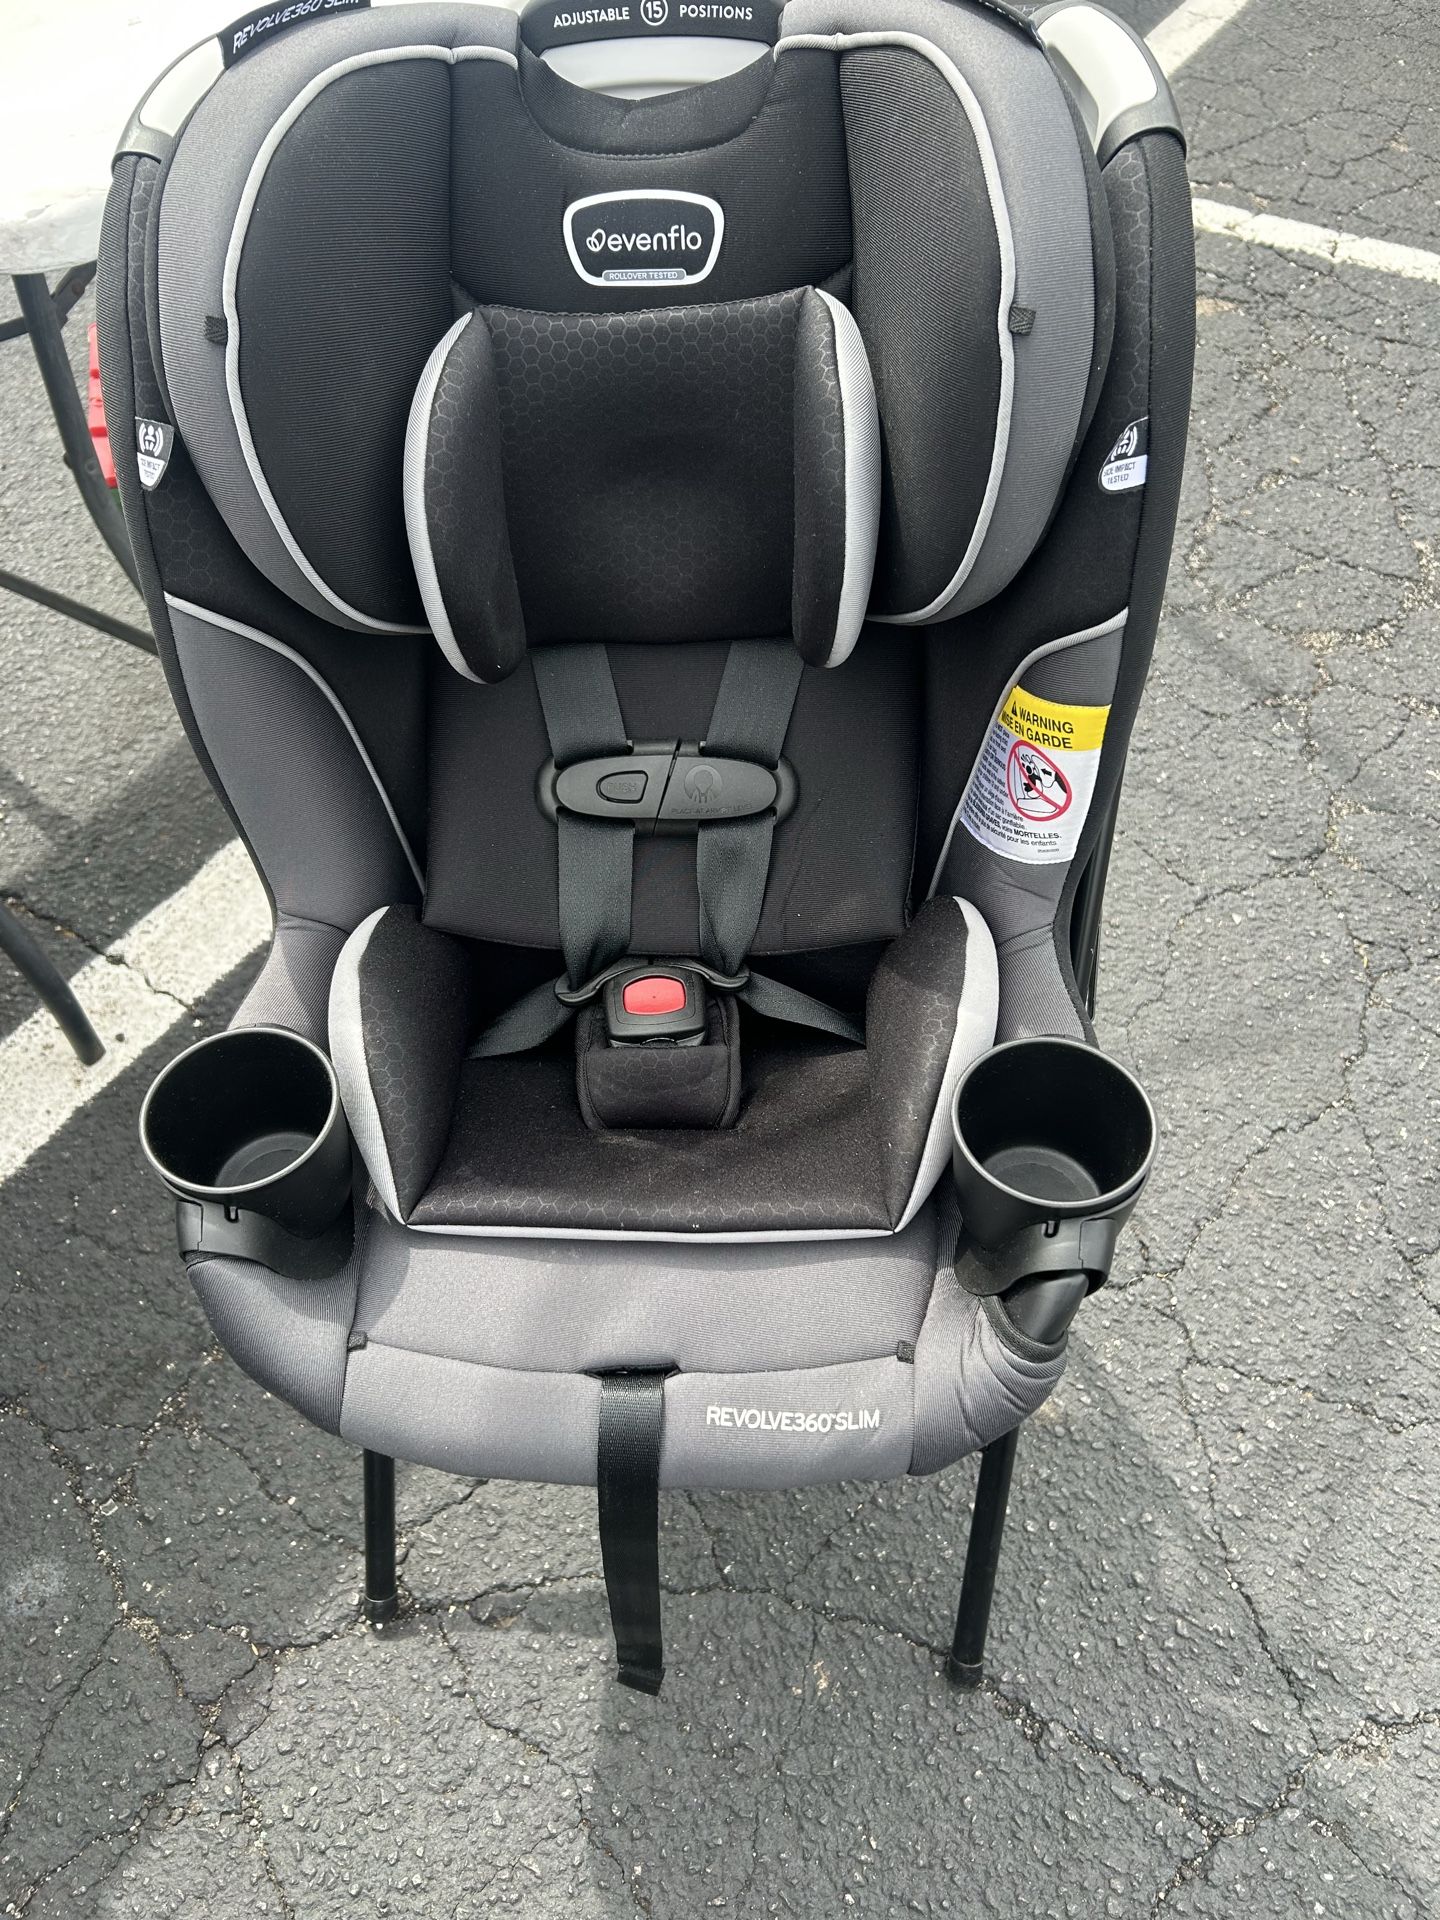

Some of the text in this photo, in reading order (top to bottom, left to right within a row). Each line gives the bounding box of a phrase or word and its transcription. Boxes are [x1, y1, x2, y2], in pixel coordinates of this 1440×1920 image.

[232, 0, 321, 54] REVOLVE360
[553, 1, 753, 28] ADJUSTABLE 15 POSITIONS
[607, 225, 702, 252] evenflo
[609, 271, 678, 280] ROLLOVER TESTED
[1107, 473, 1129, 484] TESTED
[1115, 461, 1136, 472] IMPACT
[1019, 706, 1074, 734] WARNING
[1015, 720, 1024, 737] EN
[1026, 728, 1073, 749] GARDE
